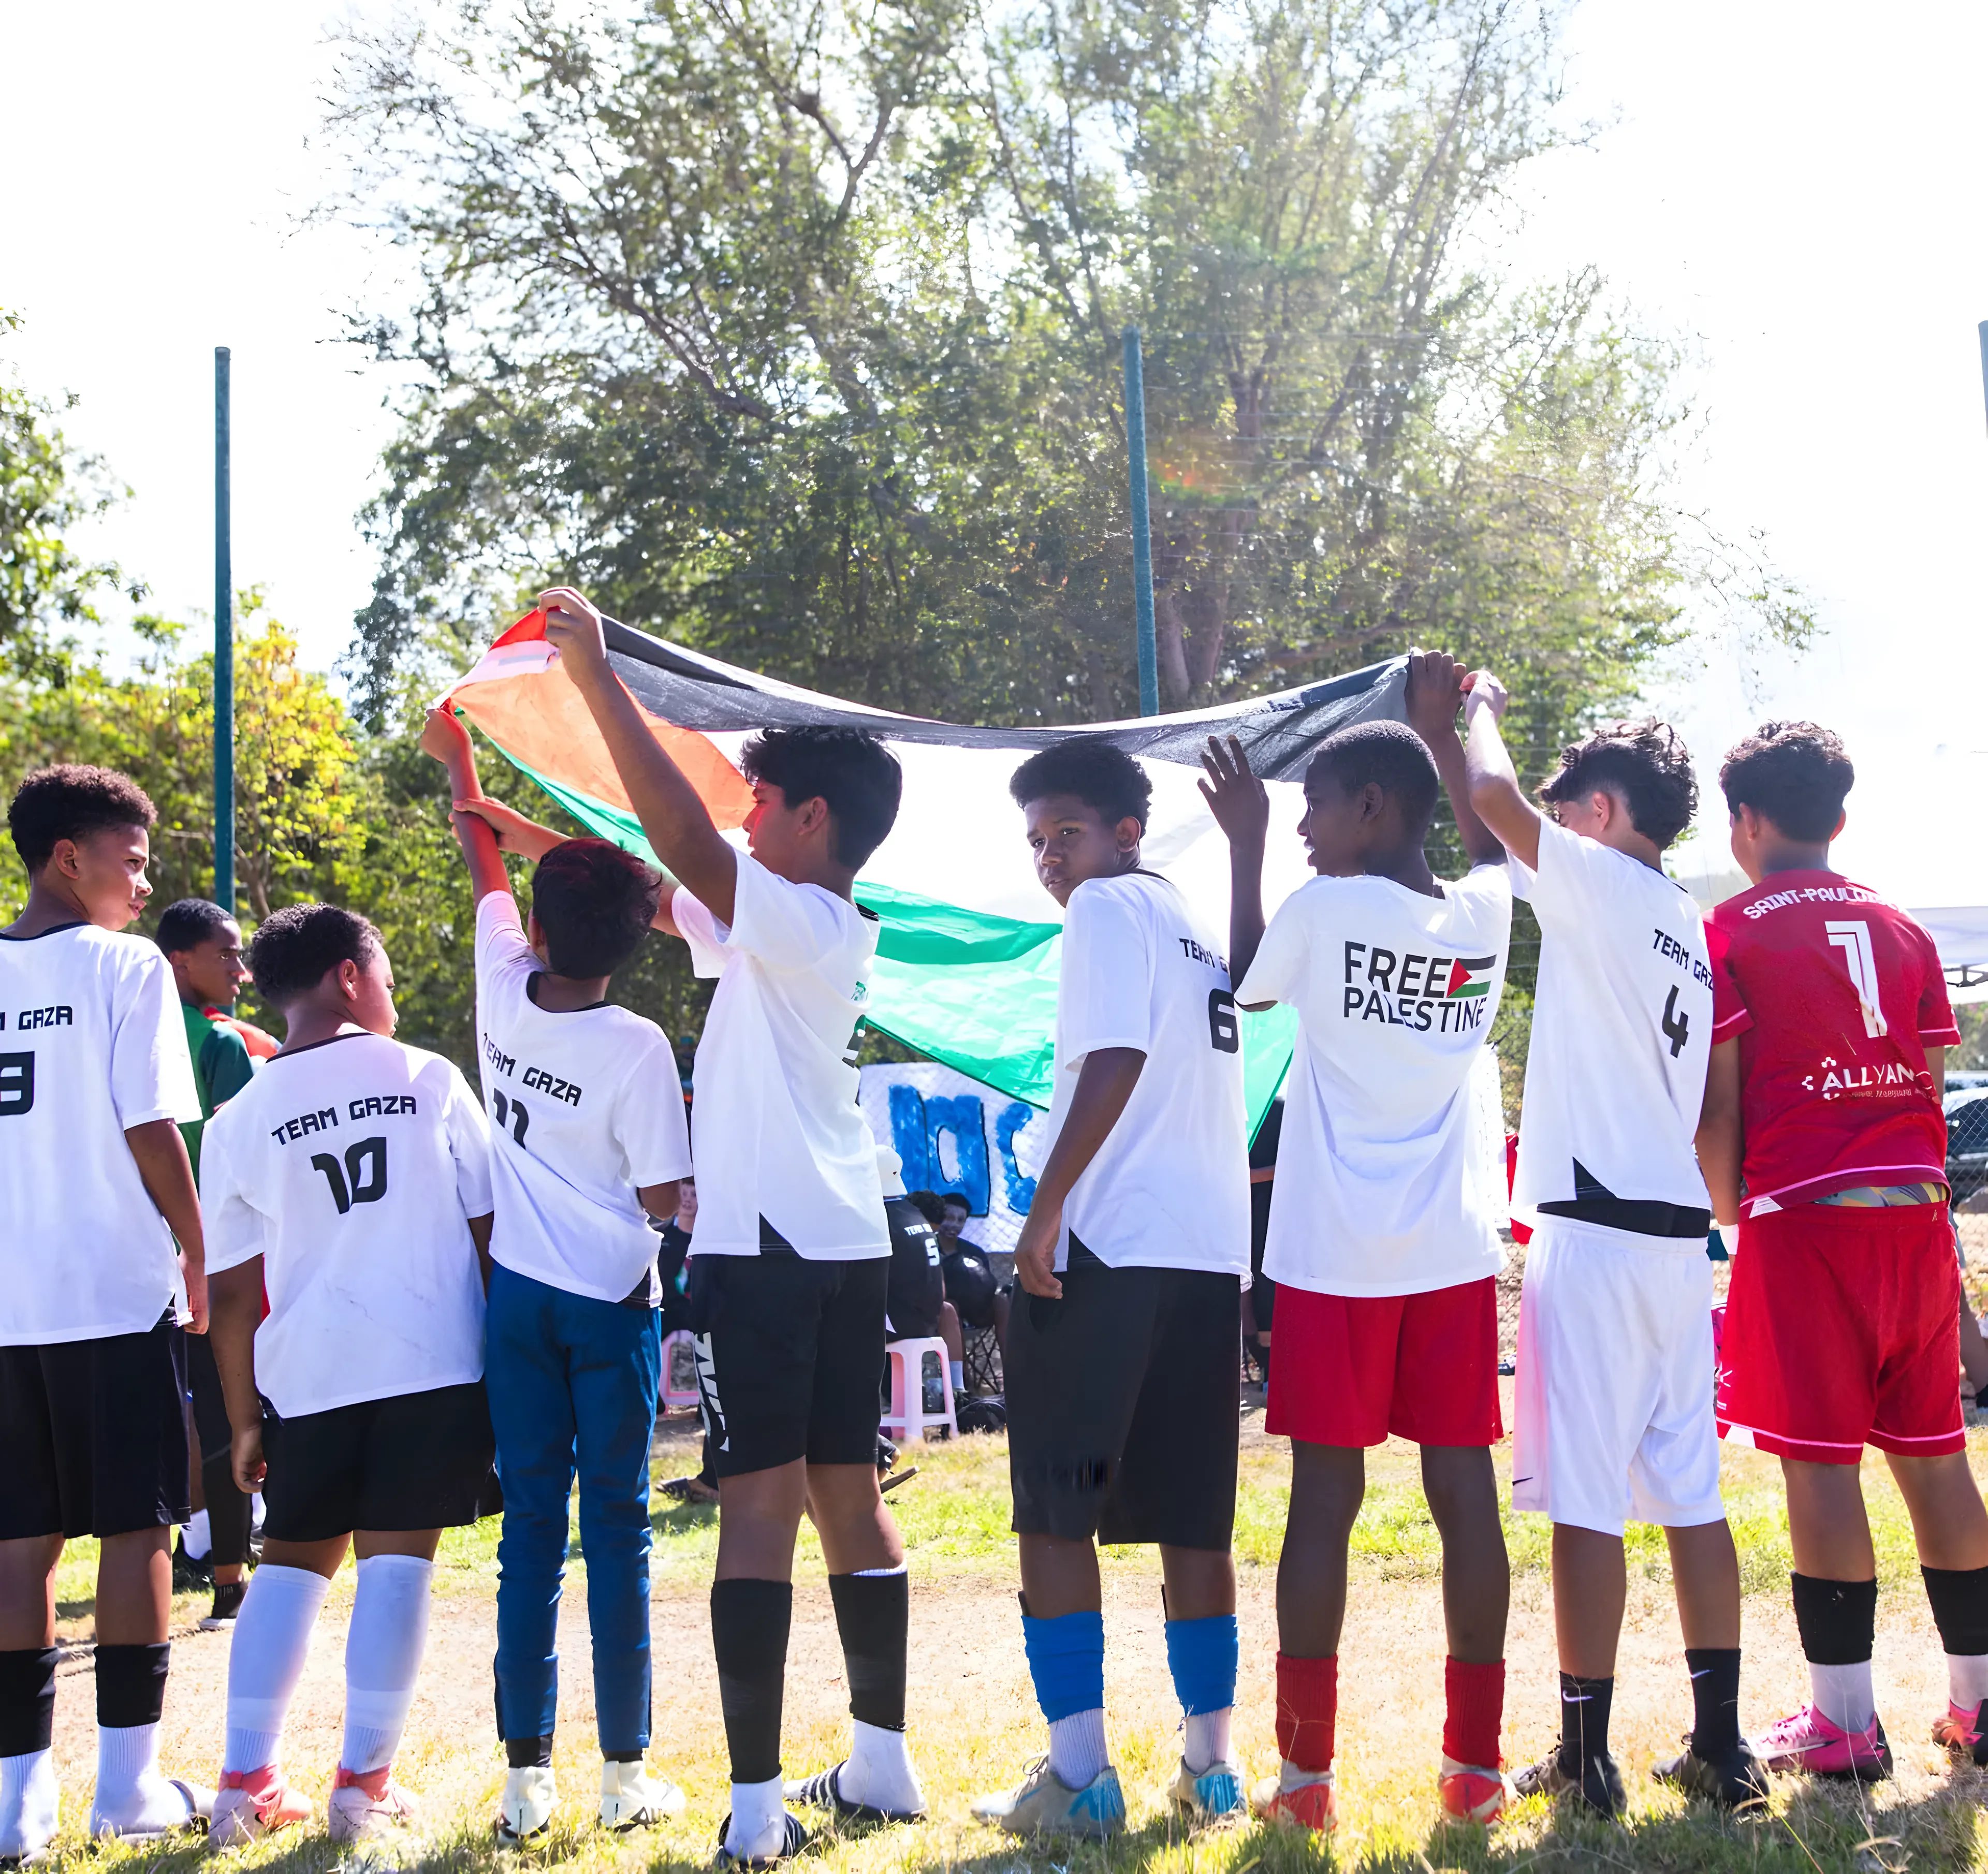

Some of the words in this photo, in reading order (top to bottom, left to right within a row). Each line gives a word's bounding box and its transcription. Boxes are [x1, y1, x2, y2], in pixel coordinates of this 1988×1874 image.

[1345, 941, 1453, 999] FREE
[1653, 928, 1689, 970] TEAM
[1693, 960, 1714, 991] GAZ
[1824, 920, 1888, 1038] 1
[18, 1006, 72, 1030] GAZA
[1208, 988, 1239, 1054] 6
[1344, 986, 1487, 1032] PALESTINE
[1662, 984, 1689, 1059] 4
[522, 1066, 582, 1107] GAZA
[271, 1107, 339, 1145] TEAM
[349, 1095, 416, 1121] GAZA
[310, 1137, 387, 1214] 10
